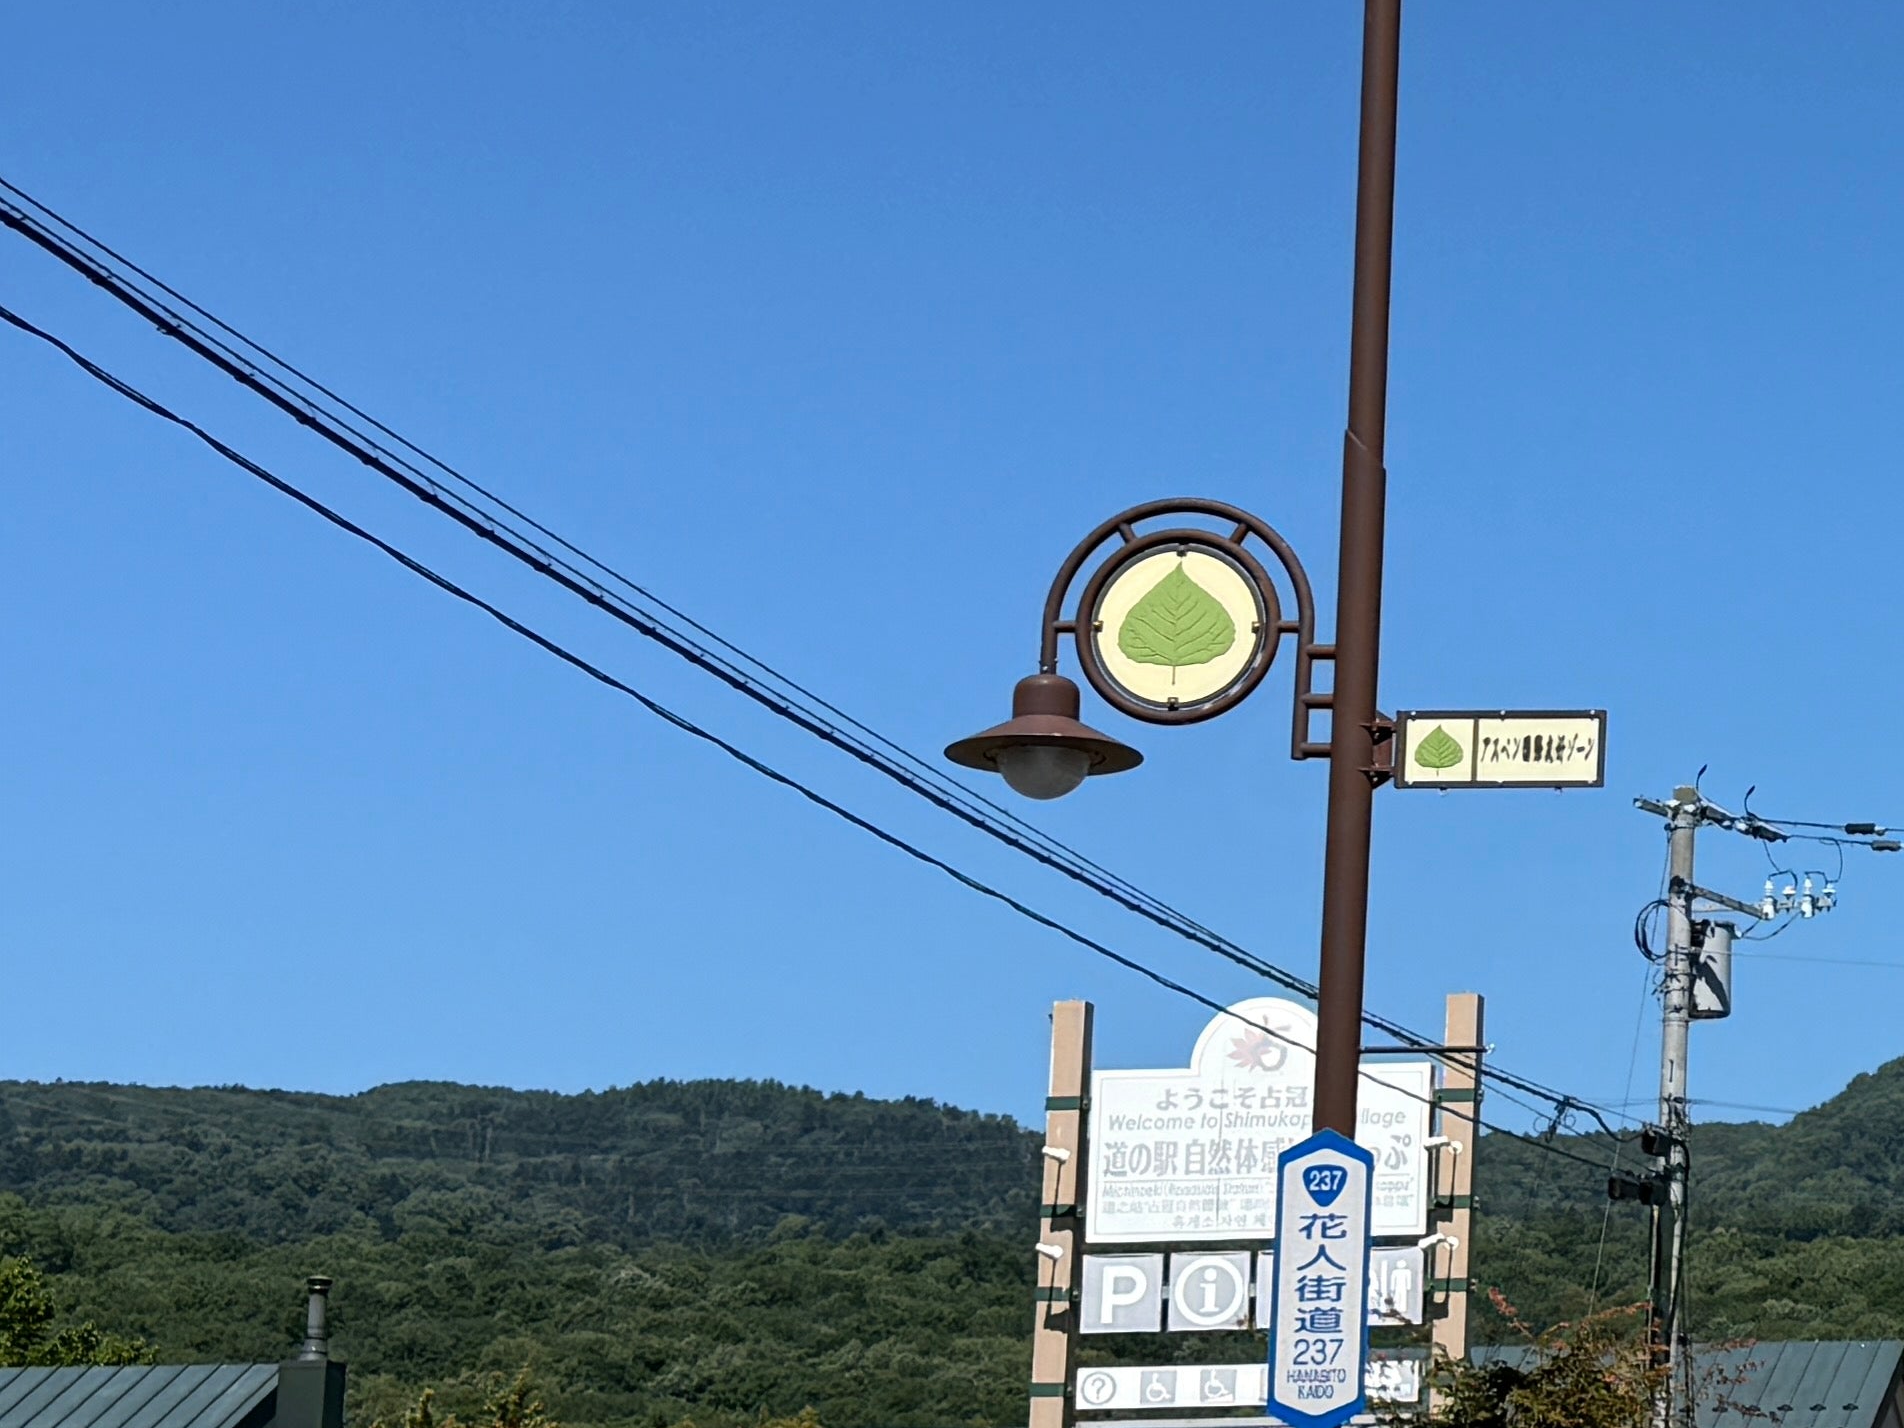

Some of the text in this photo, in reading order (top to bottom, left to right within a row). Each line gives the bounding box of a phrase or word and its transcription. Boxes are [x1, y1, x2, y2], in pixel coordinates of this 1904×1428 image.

[1109, 1107, 1406, 1130] Welcome to Shimukap llage
[1309, 1170, 1342, 1191] 237
[1294, 1213, 1348, 1333] 花人街道
[1100, 1264, 1147, 1323] P
[1293, 1339, 1344, 1365] 237
[1298, 1384, 1334, 1399] KAIDO
